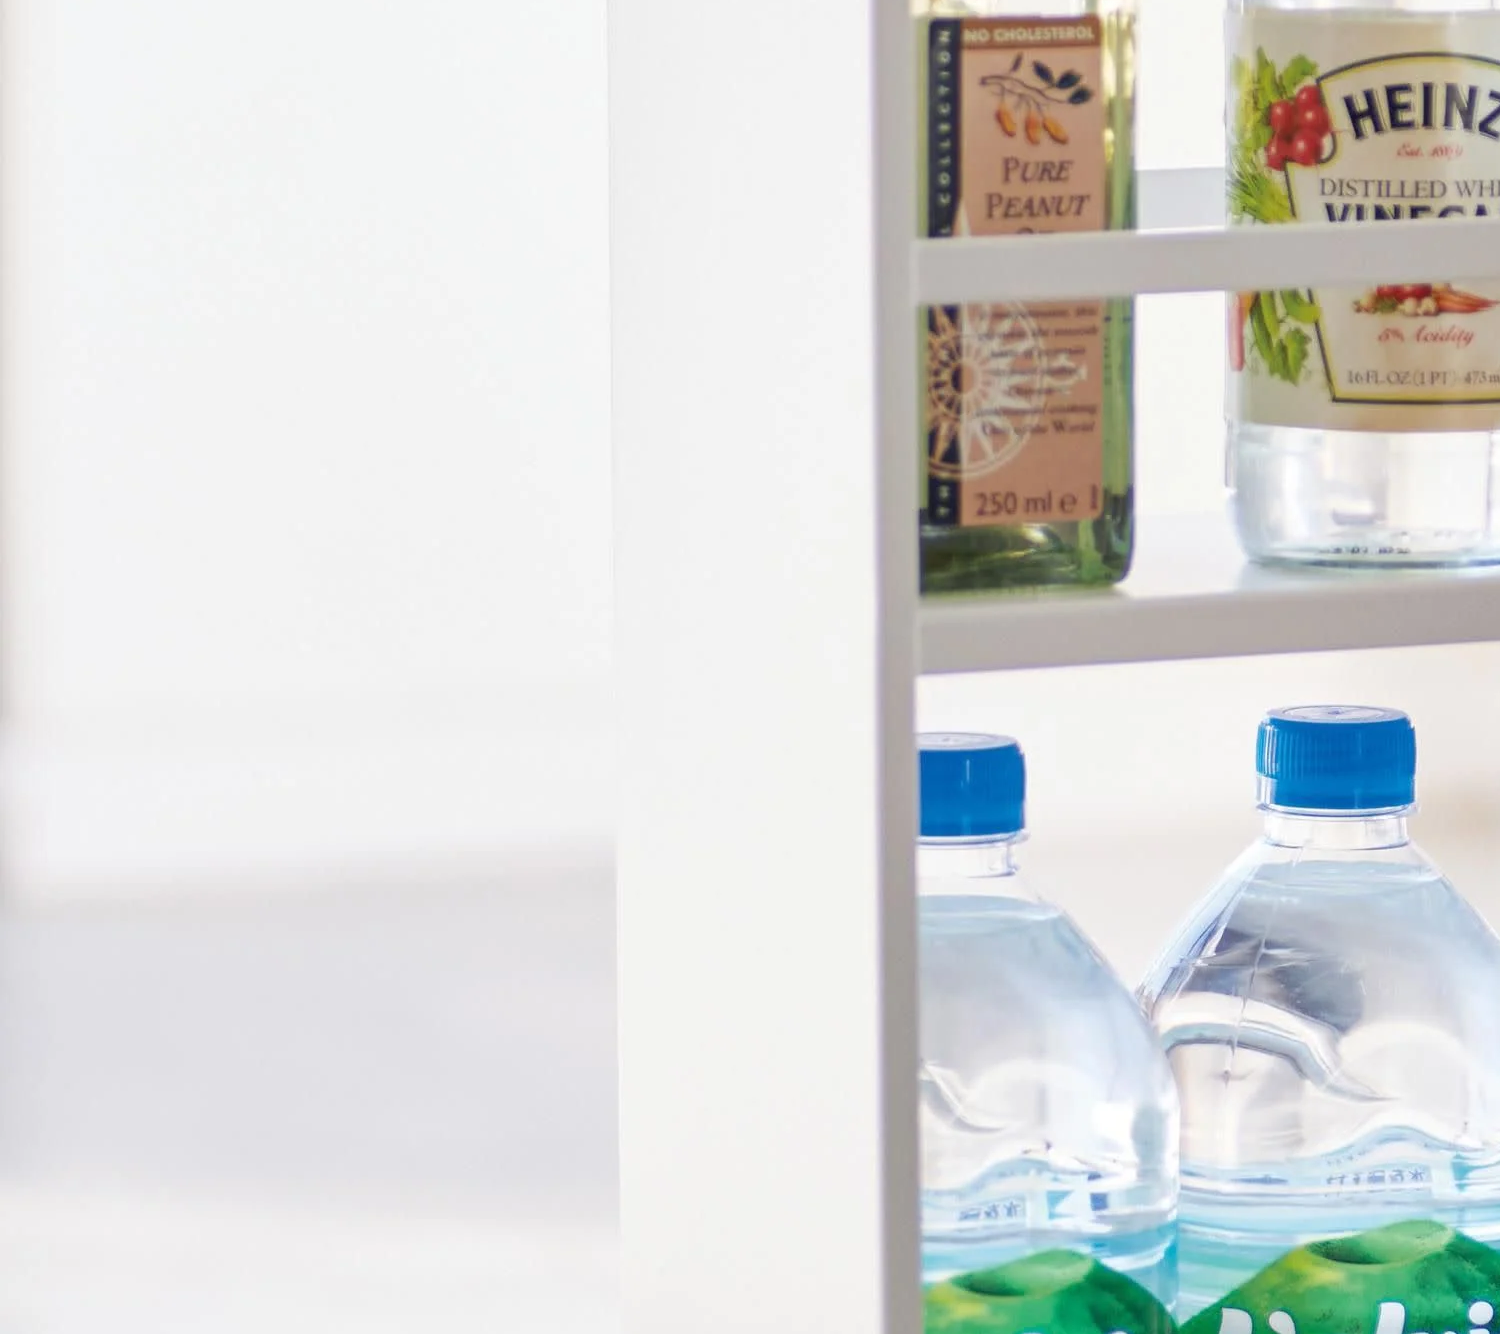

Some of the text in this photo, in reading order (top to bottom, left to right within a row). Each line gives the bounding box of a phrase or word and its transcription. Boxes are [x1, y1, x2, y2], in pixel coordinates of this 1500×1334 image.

[963, 25, 1096, 42] NO CHOLESTEROL
[1001, 155, 1075, 185] PURE
[1319, 177, 1447, 199] DISTILLED
[984, 190, 1092, 219] PEANUT
[974, 490, 1018, 516] 250
[1025, 489, 1053, 513] ml
